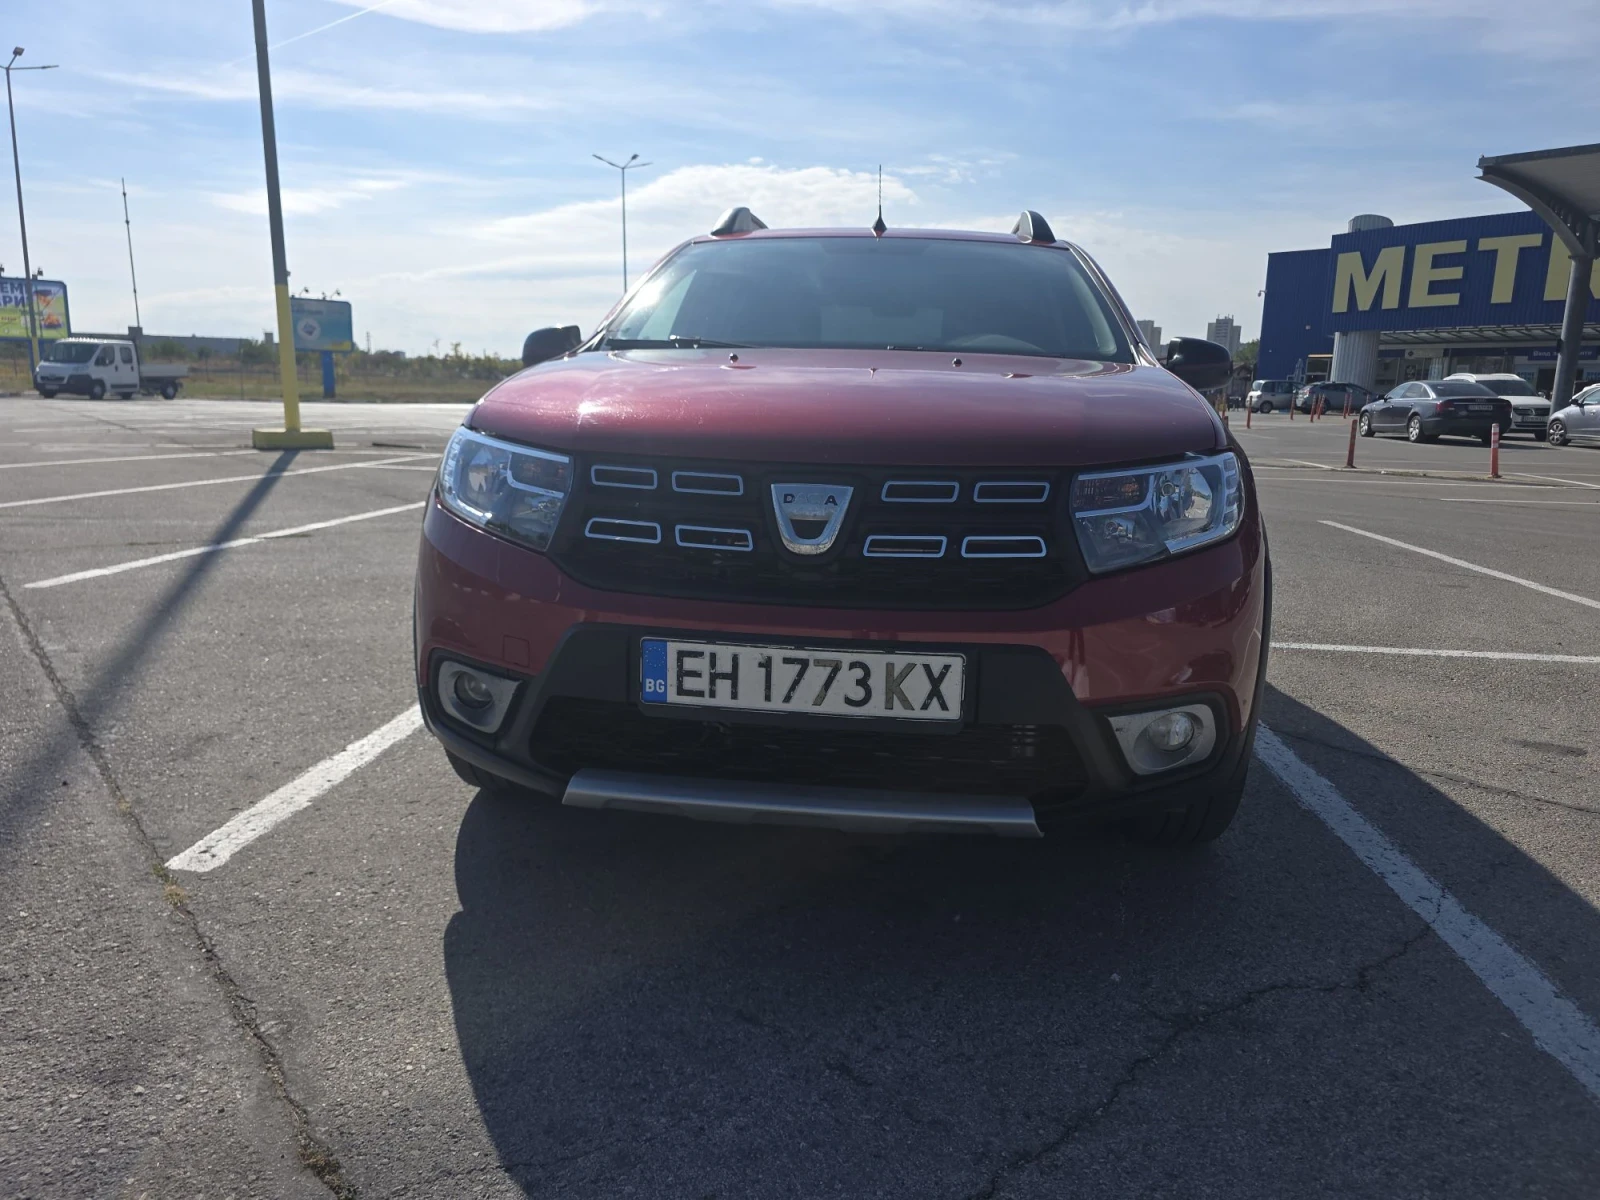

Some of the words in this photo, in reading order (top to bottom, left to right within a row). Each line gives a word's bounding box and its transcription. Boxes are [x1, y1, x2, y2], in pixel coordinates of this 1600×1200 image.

[0, 295, 25, 308] РИ
[645, 679, 665, 693] BG
[676, 650, 740, 700] EH
[757, 655, 873, 707] 1773
[884, 662, 951, 711] KX
